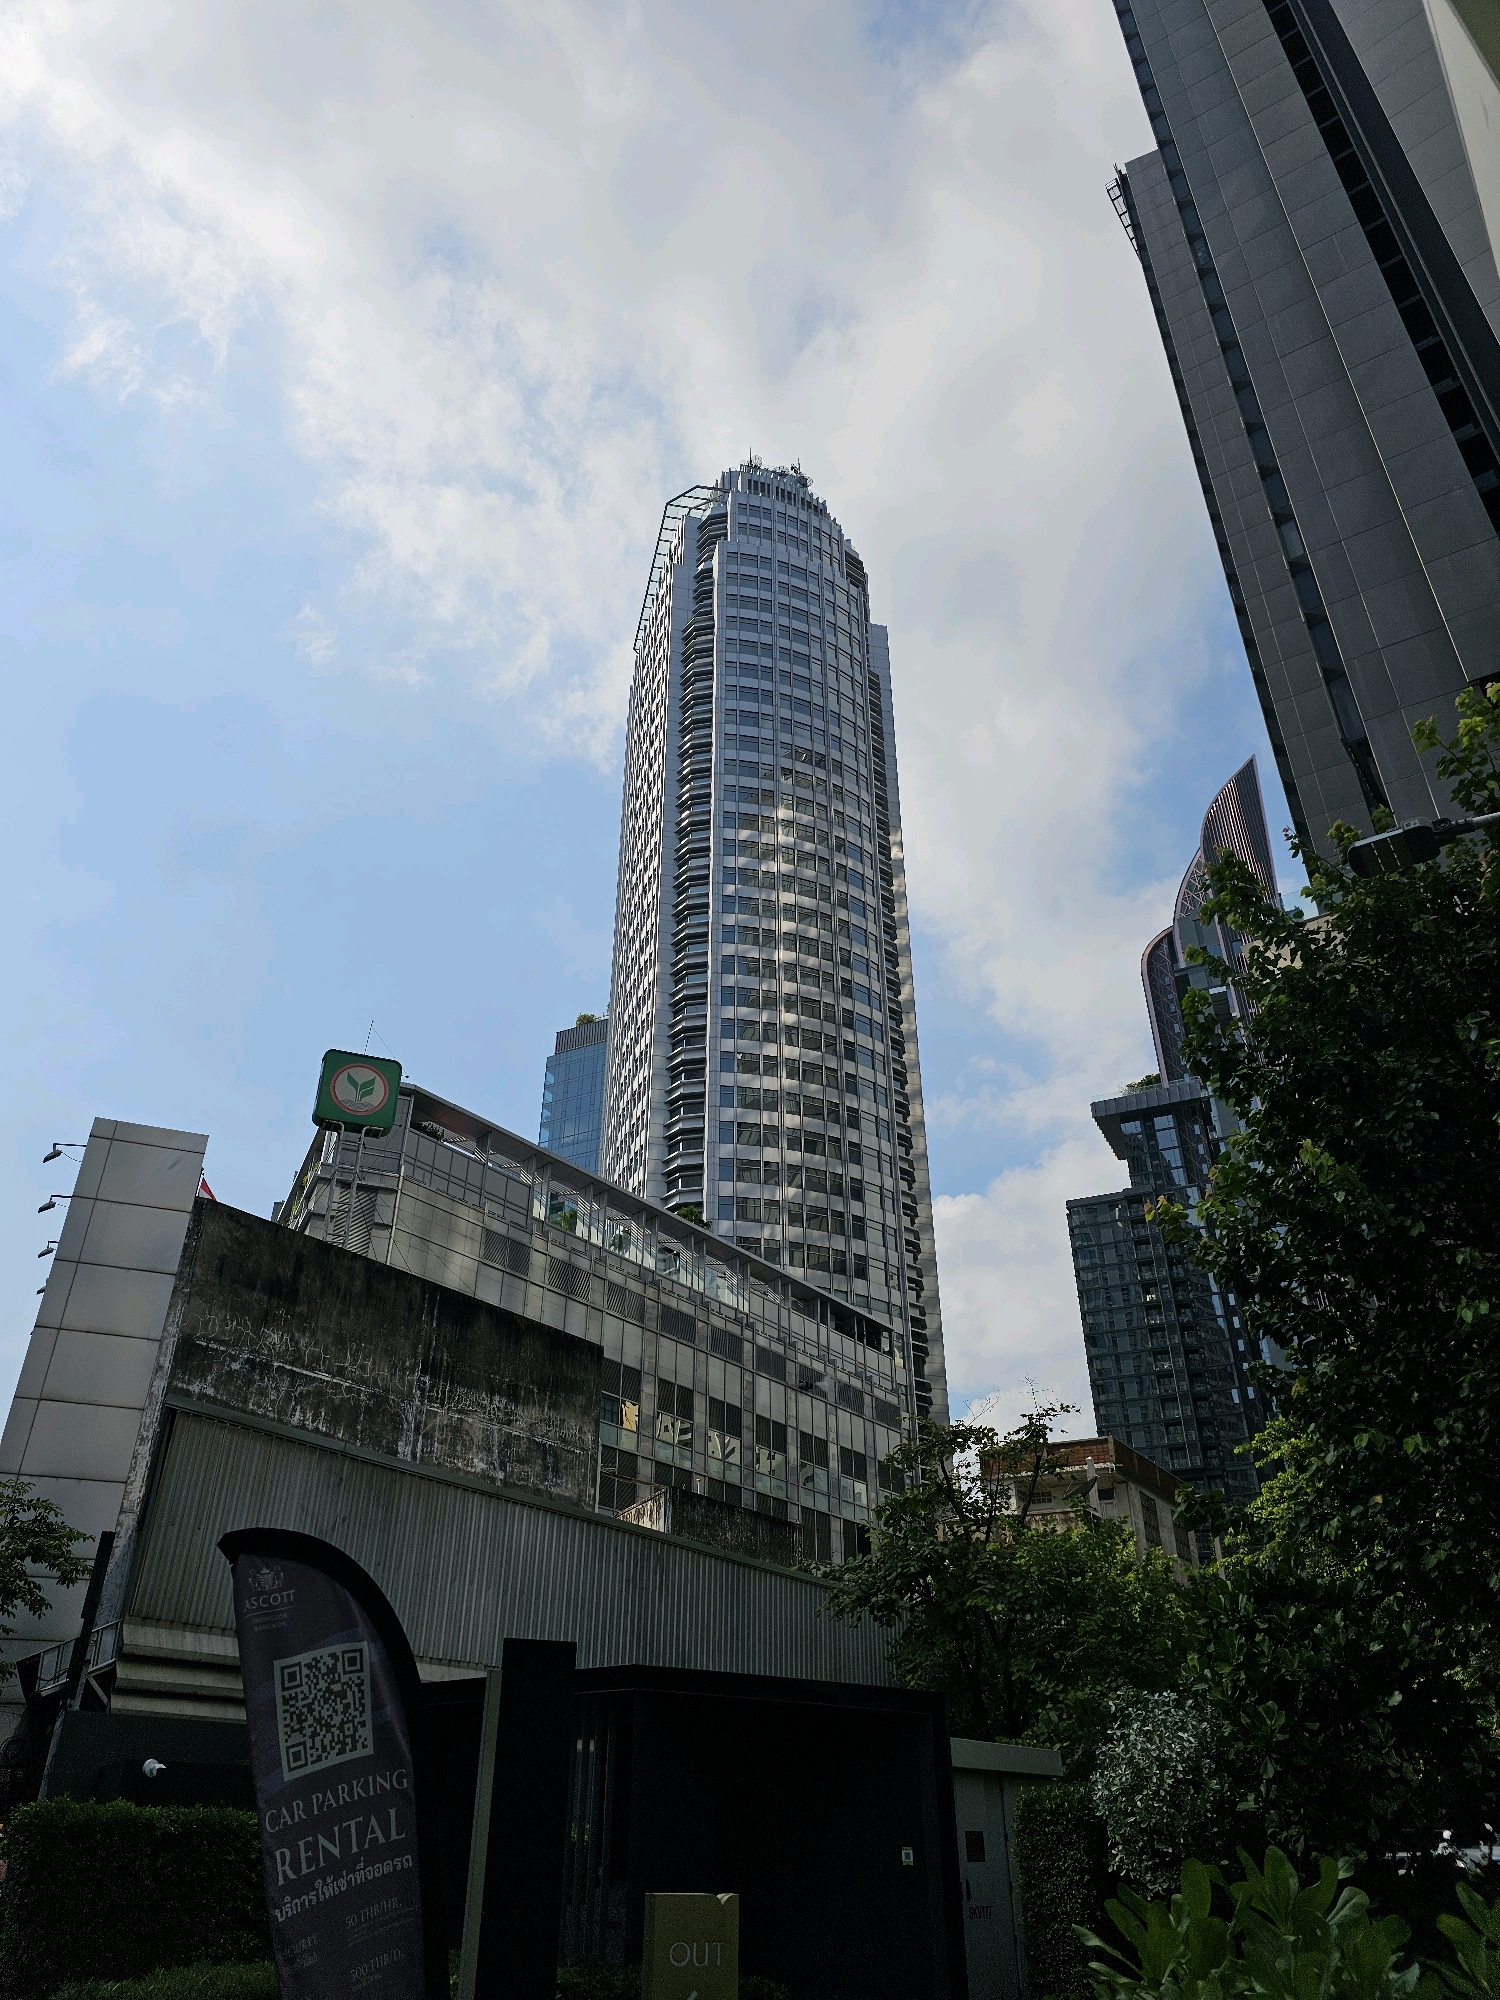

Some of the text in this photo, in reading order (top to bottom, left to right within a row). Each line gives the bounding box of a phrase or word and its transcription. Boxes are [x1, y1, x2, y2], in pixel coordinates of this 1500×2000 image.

[244, 1589, 295, 1612] ASCOTT
[265, 1769, 408, 1832] CAR PARKING
[274, 1808, 406, 1887] RENTAL
[274, 1855, 413, 1922] บริการให้เช่าที่จอดรถ
[669, 1941, 726, 1968] OUT
